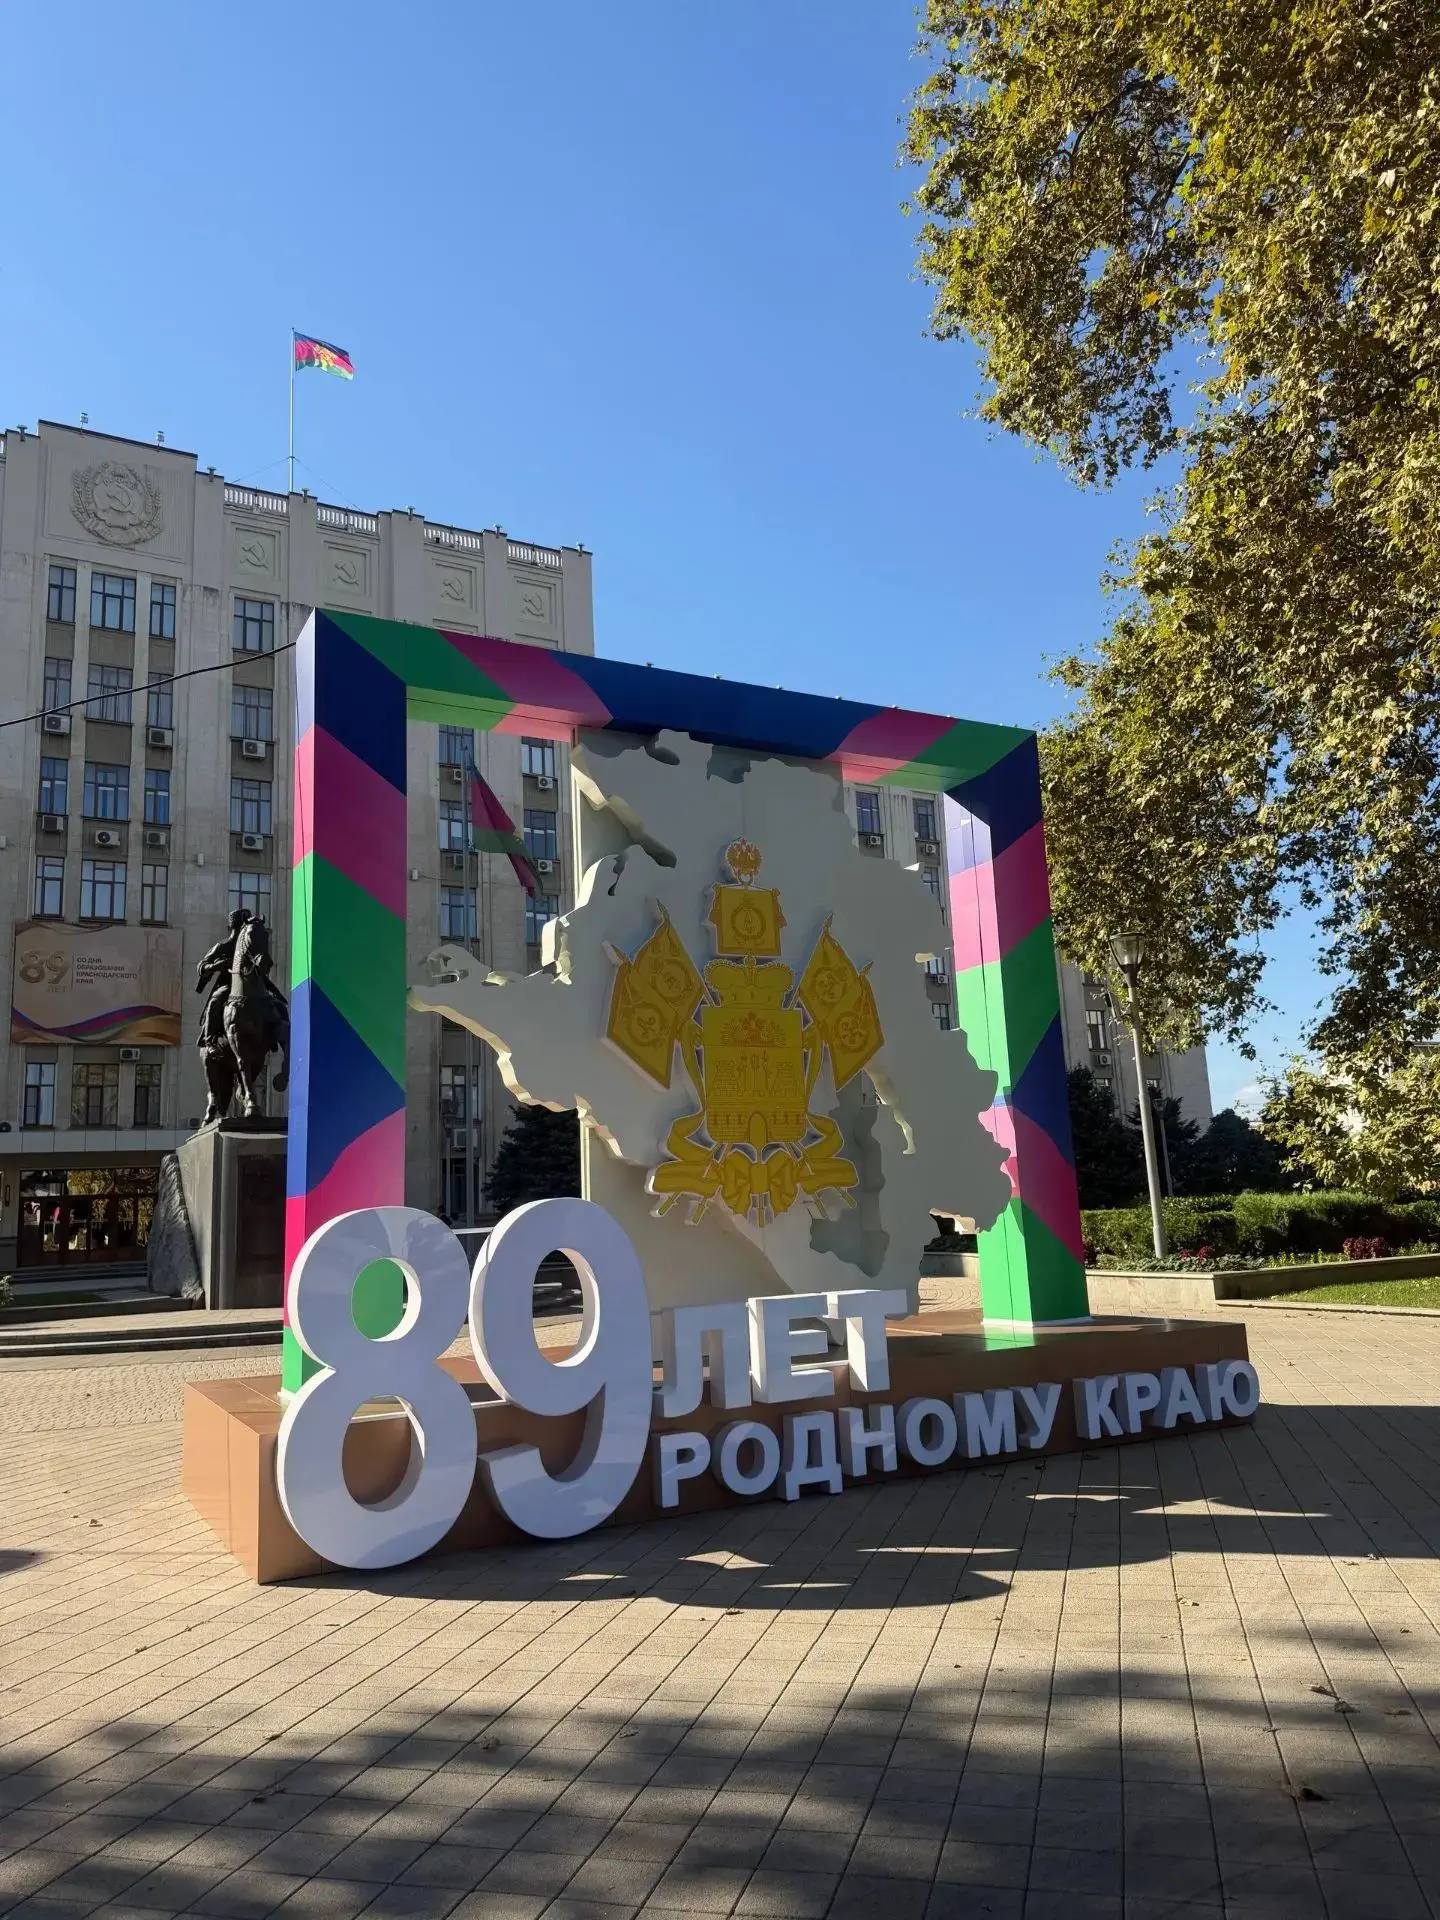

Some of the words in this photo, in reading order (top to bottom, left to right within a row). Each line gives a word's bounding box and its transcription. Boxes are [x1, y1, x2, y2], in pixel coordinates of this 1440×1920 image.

[19, 951, 70, 984] 89
[276, 1197, 655, 1570] 89
[653, 1289, 908, 1419] ЛЕТ
[652, 1382, 1062, 1508] РОДНОМУ
[1073, 1359, 1261, 1441] КРАЮ
